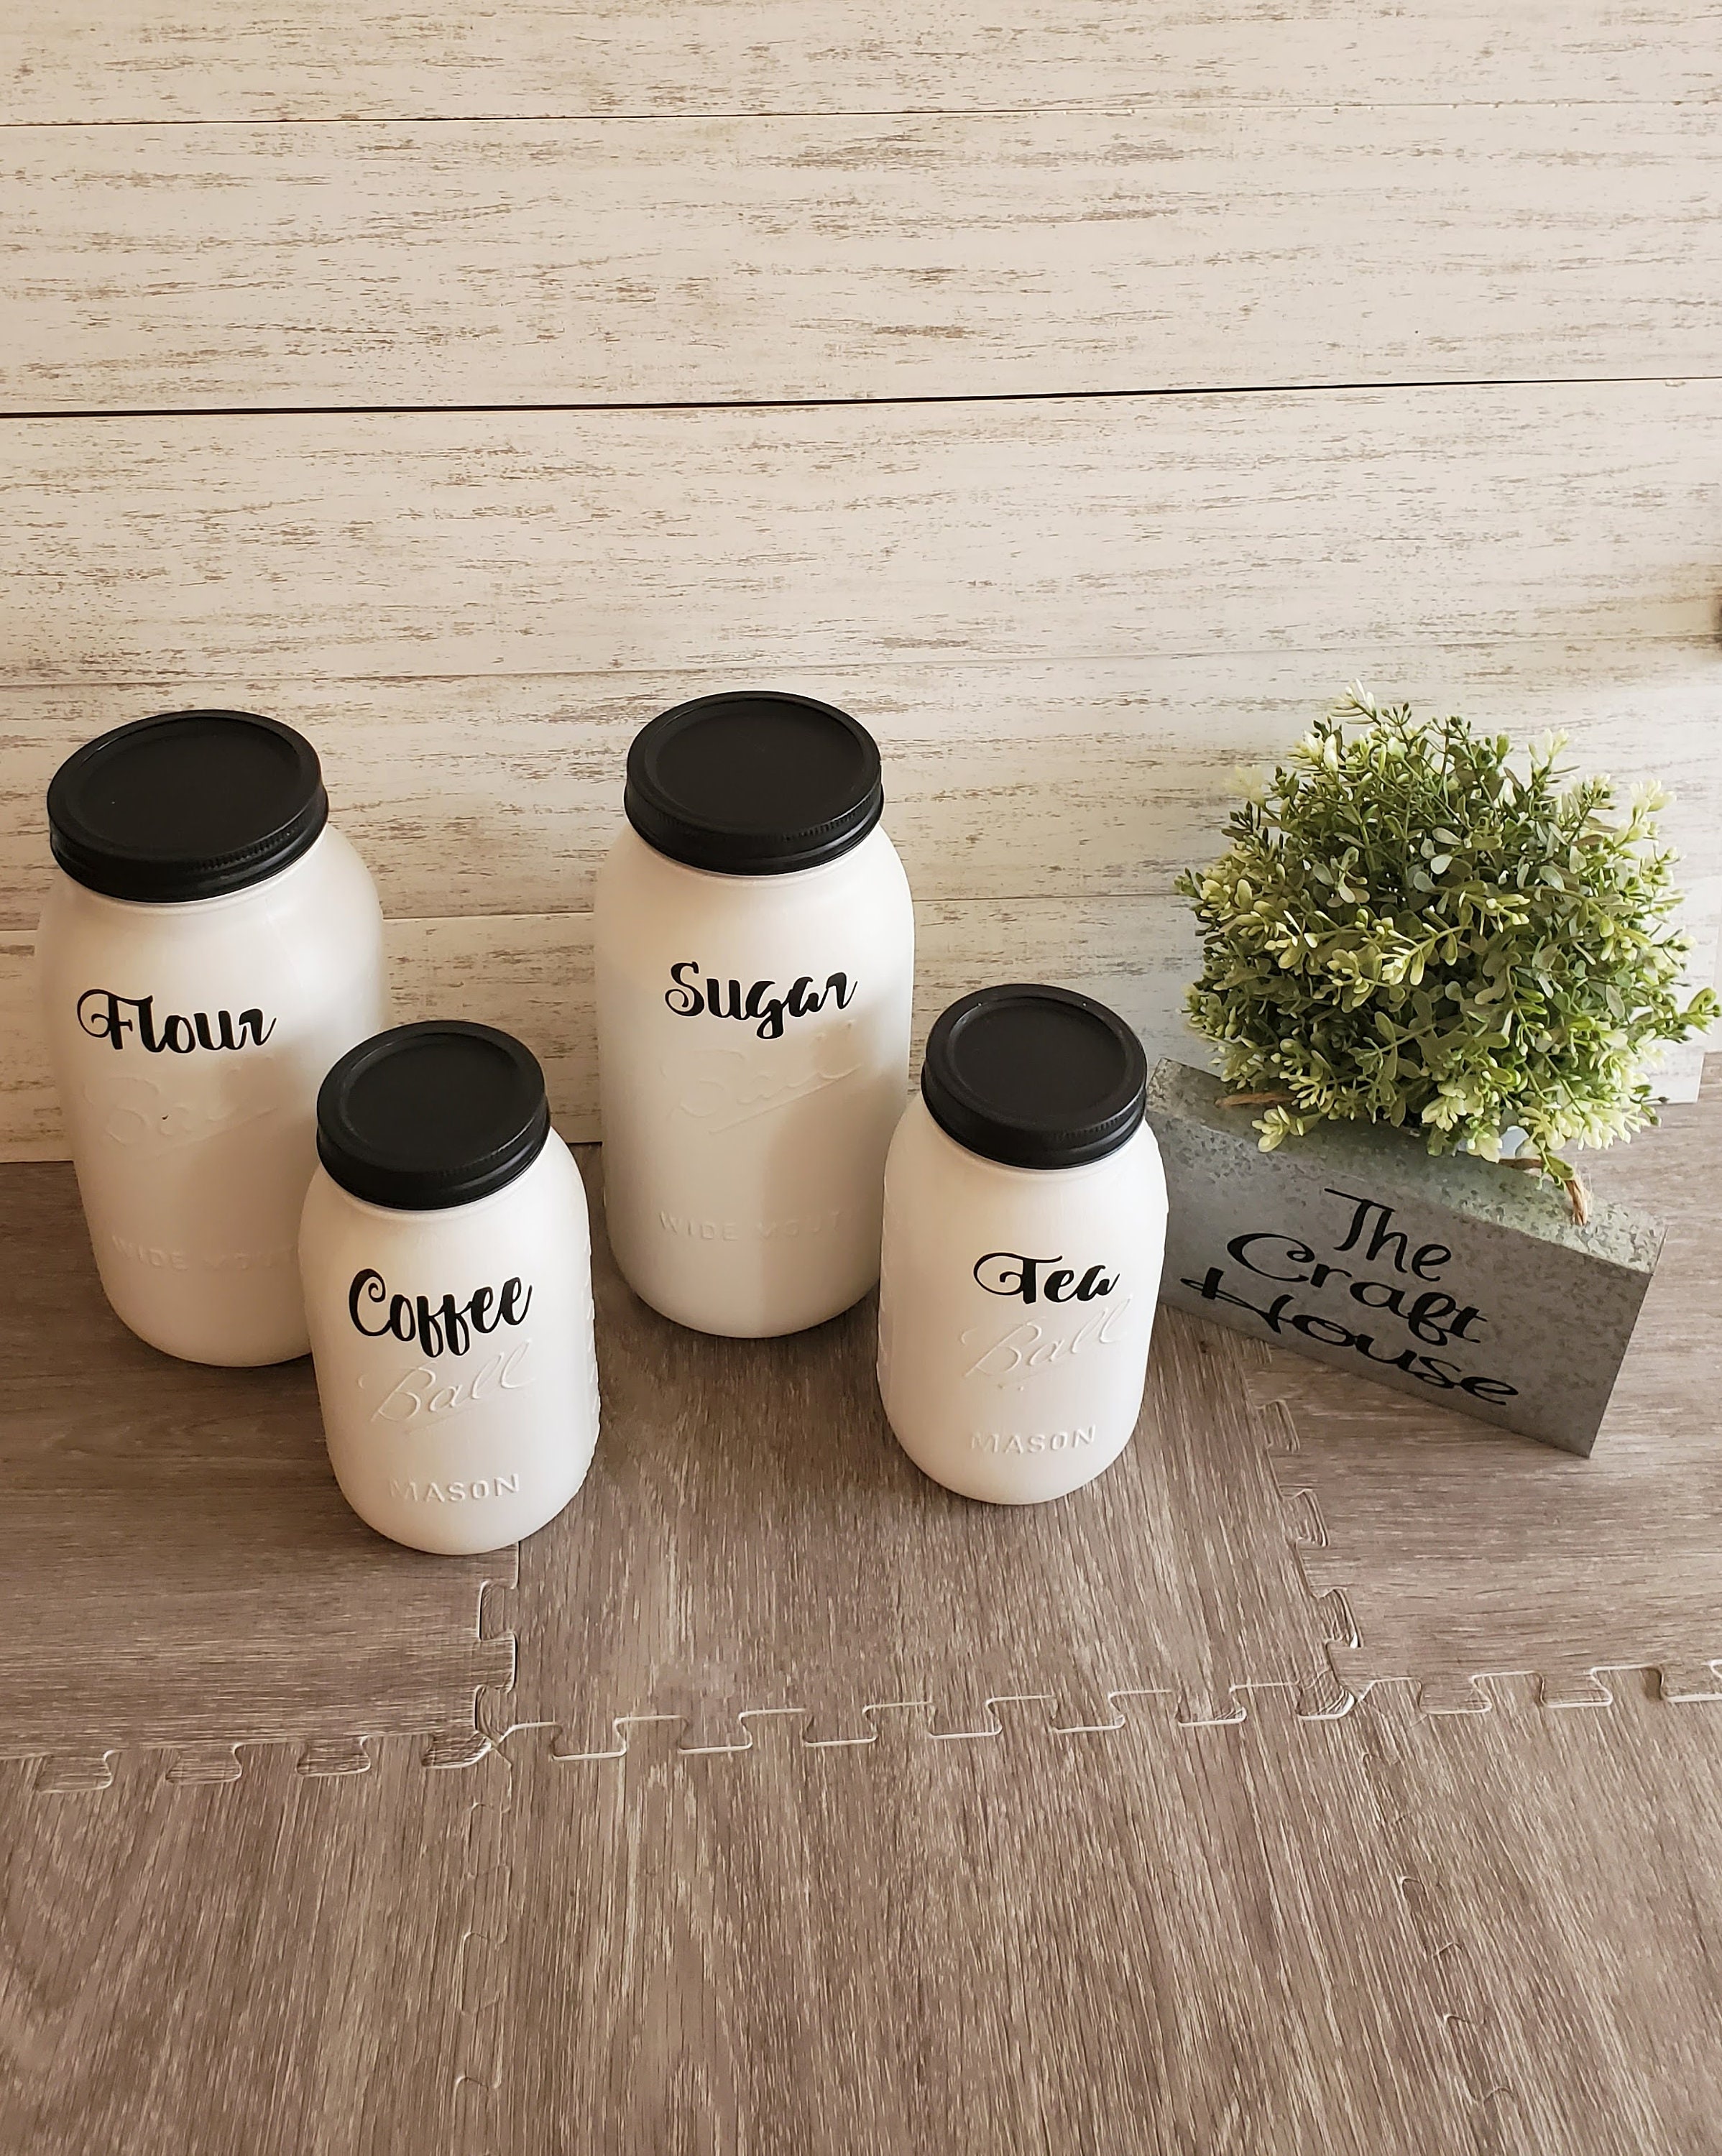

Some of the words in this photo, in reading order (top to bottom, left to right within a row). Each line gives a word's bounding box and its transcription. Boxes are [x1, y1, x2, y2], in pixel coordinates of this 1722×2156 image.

[76, 988, 277, 1054] Flour
[665, 961, 858, 1040] Sugar
[659, 1210, 739, 1242] WIDE
[1324, 1187, 1452, 1282] The
[349, 1268, 533, 1358] Coffee
[973, 1252, 1120, 1304] Tea
[1226, 1232, 1488, 1346] Craft
[960, 1294, 1133, 1378] Ball
[1180, 1266, 1519, 1406] House
[358, 1337, 535, 1424] Ball
[970, 1423, 1097, 1455] MASON
[389, 1473, 520, 1503] MASON
